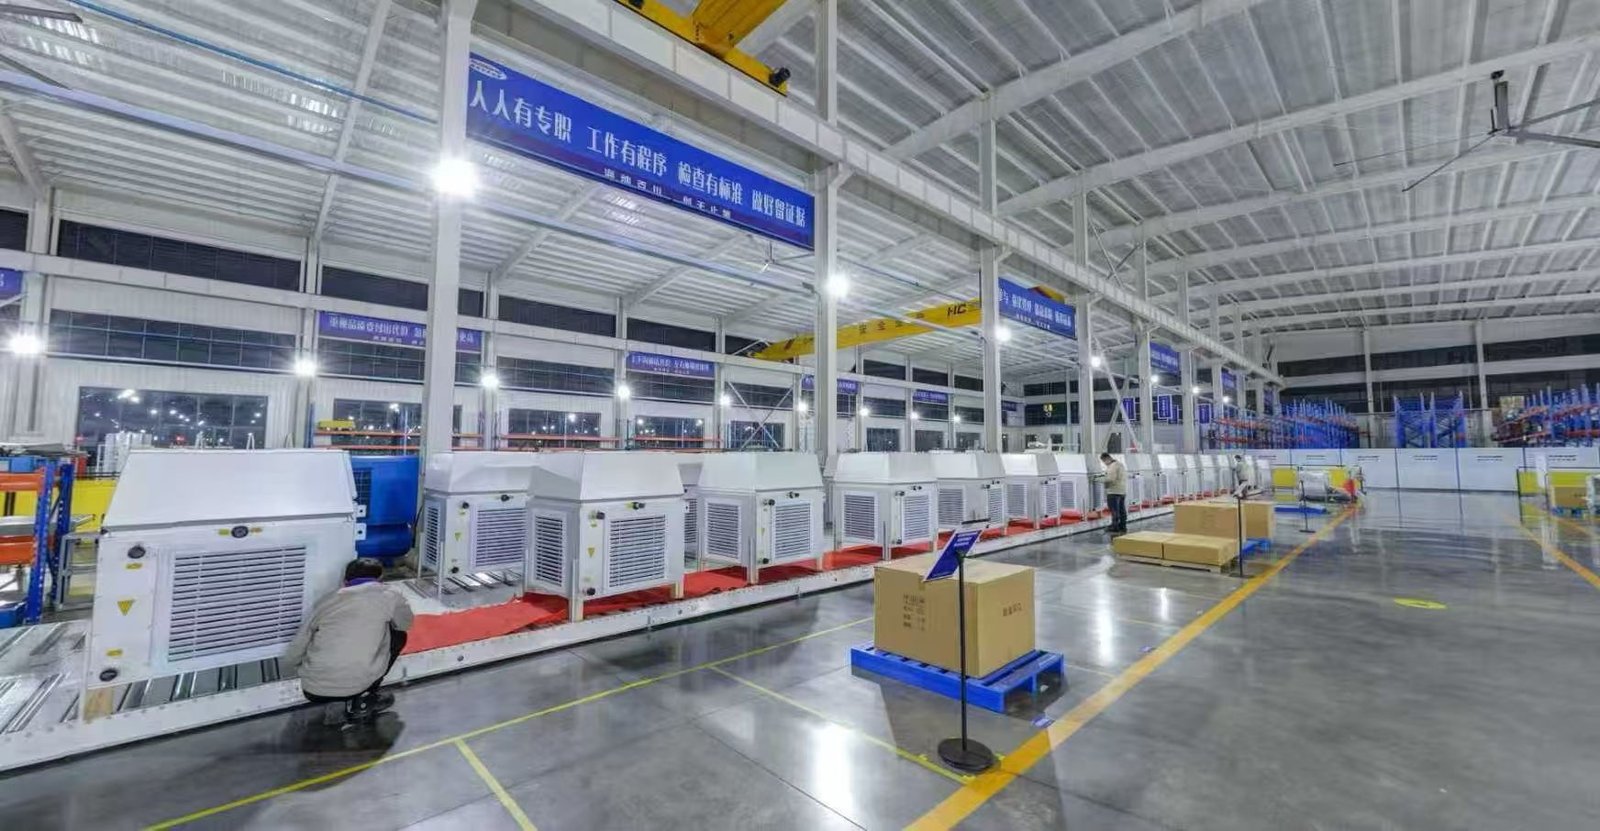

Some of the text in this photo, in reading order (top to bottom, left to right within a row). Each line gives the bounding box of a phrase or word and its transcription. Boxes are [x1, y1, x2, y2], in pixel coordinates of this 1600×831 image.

[469, 80, 806, 228] 人人有专职 工作有程序 检查有标准 做好留证据
